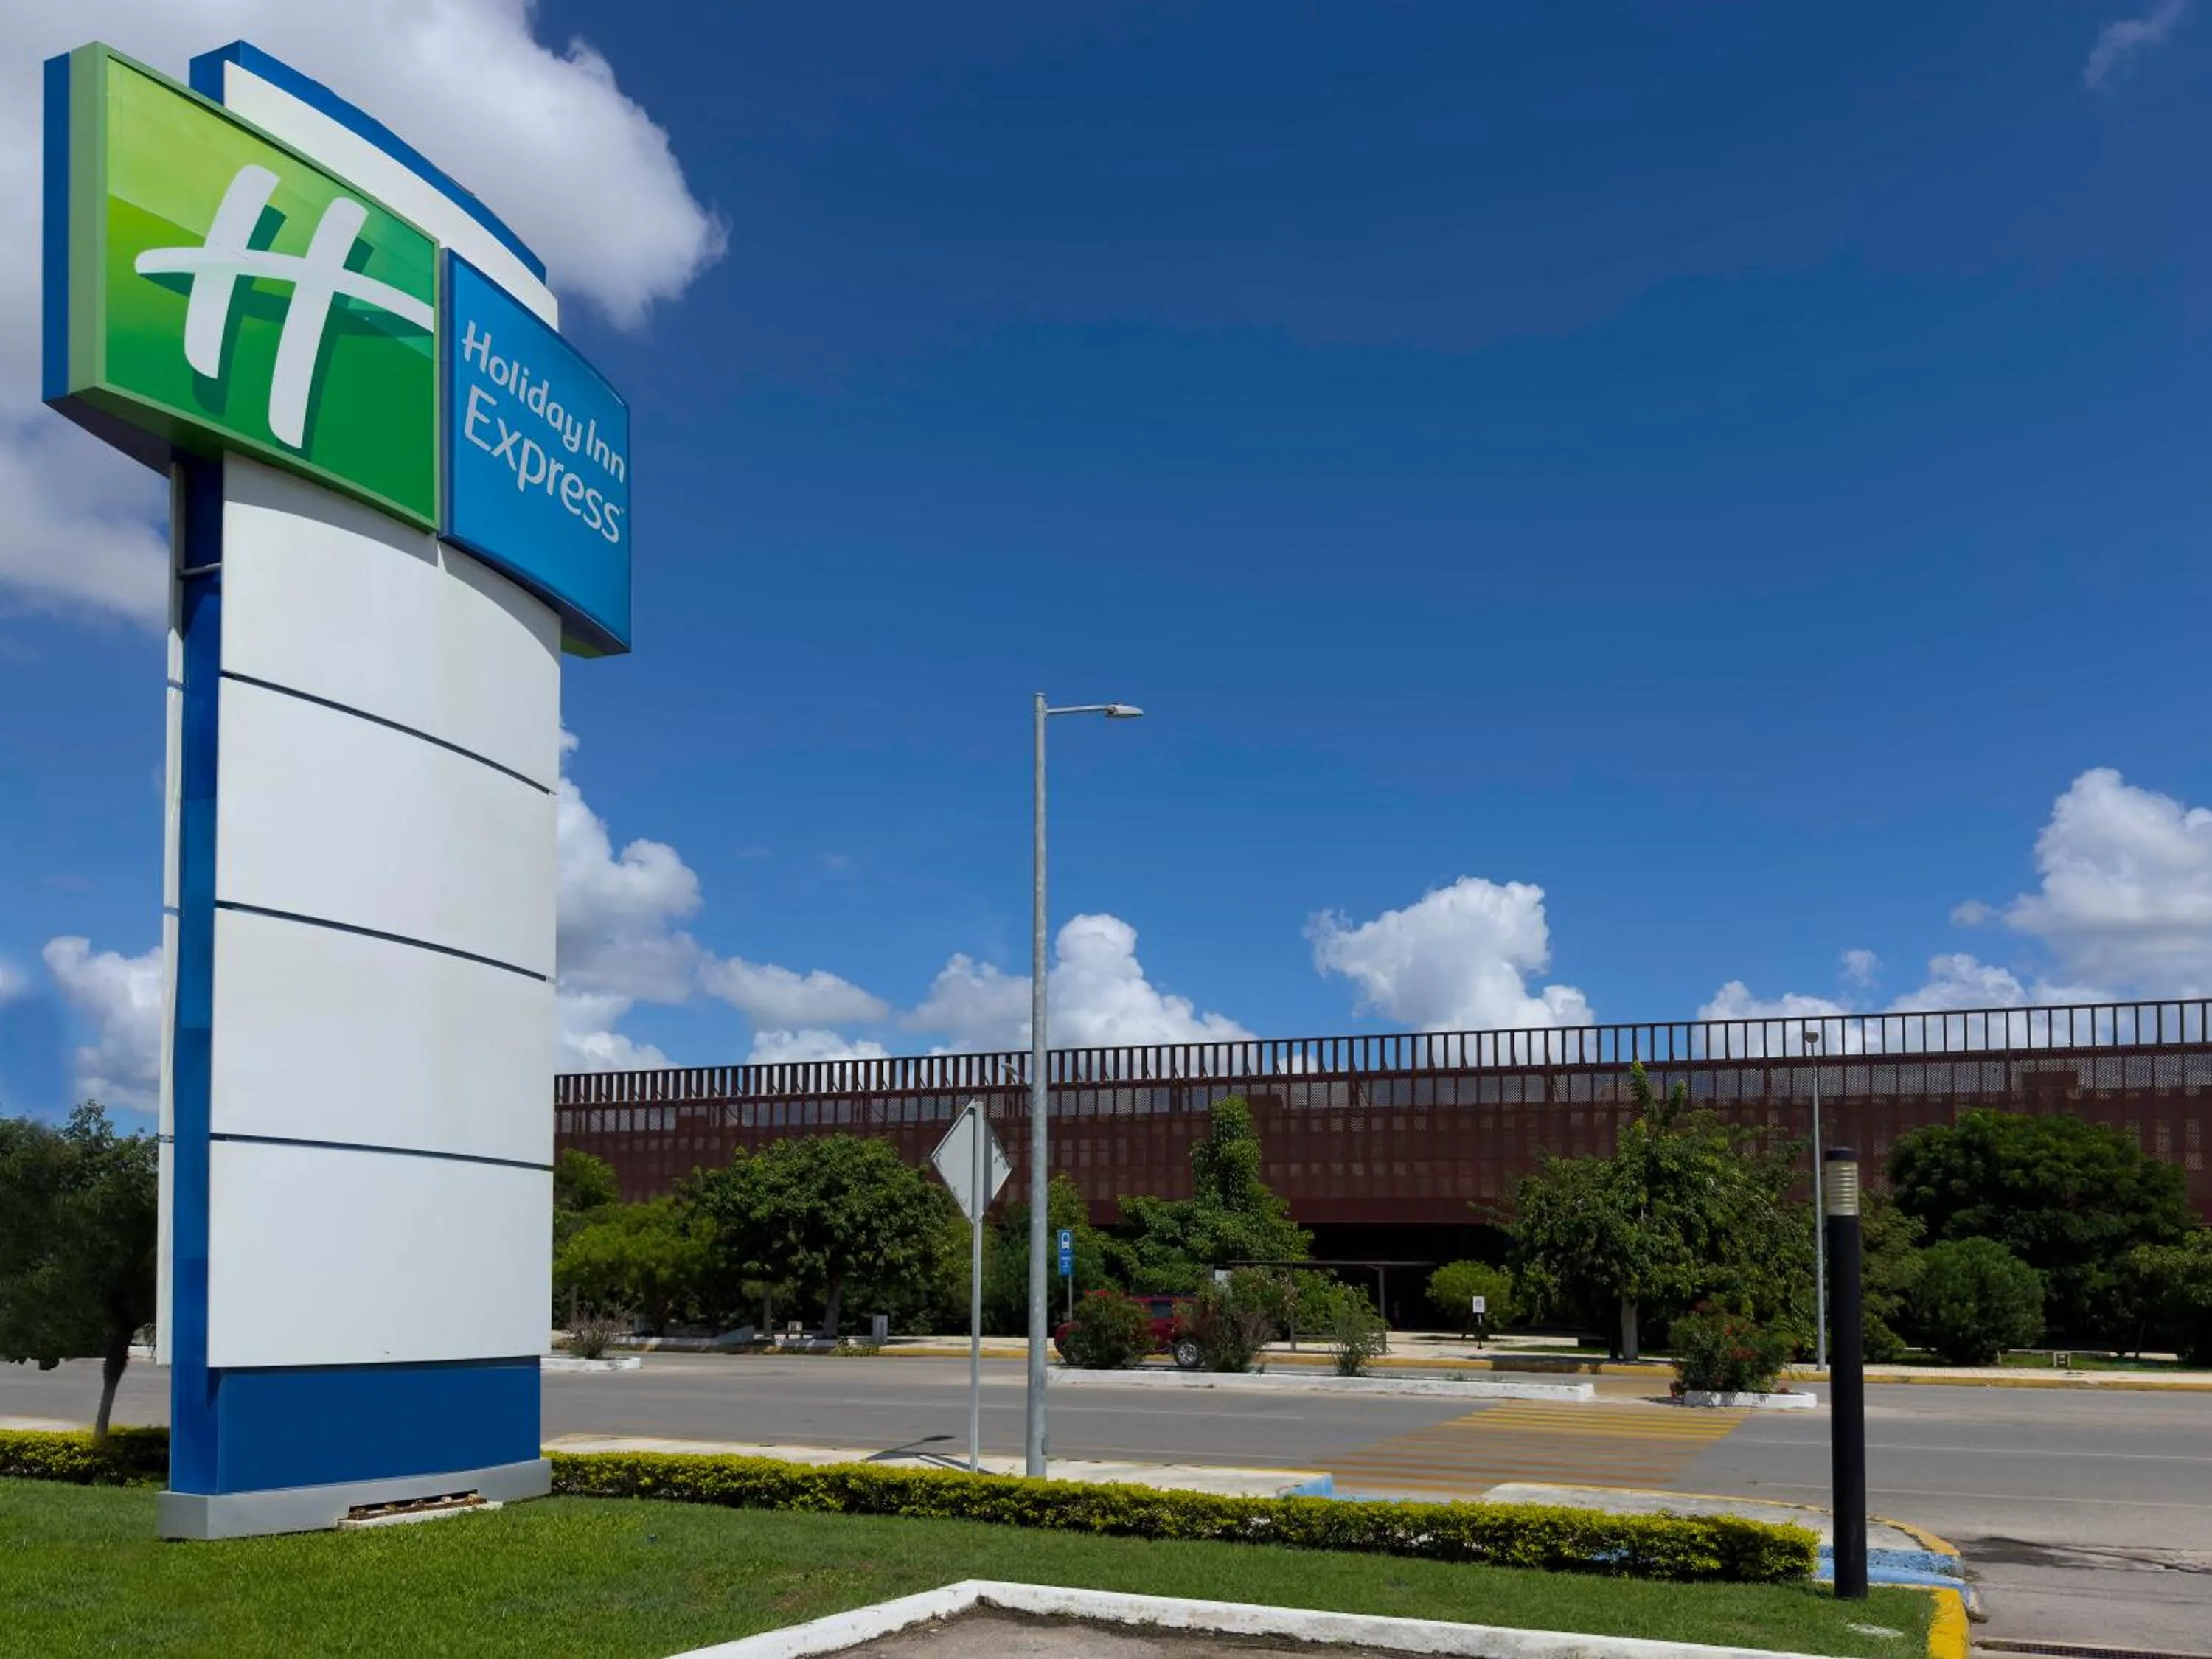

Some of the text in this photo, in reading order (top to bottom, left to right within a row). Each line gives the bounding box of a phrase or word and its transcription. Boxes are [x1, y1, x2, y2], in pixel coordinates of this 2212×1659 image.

[461, 319, 625, 484] Holiday Inn
[464, 384, 620, 543] Express
